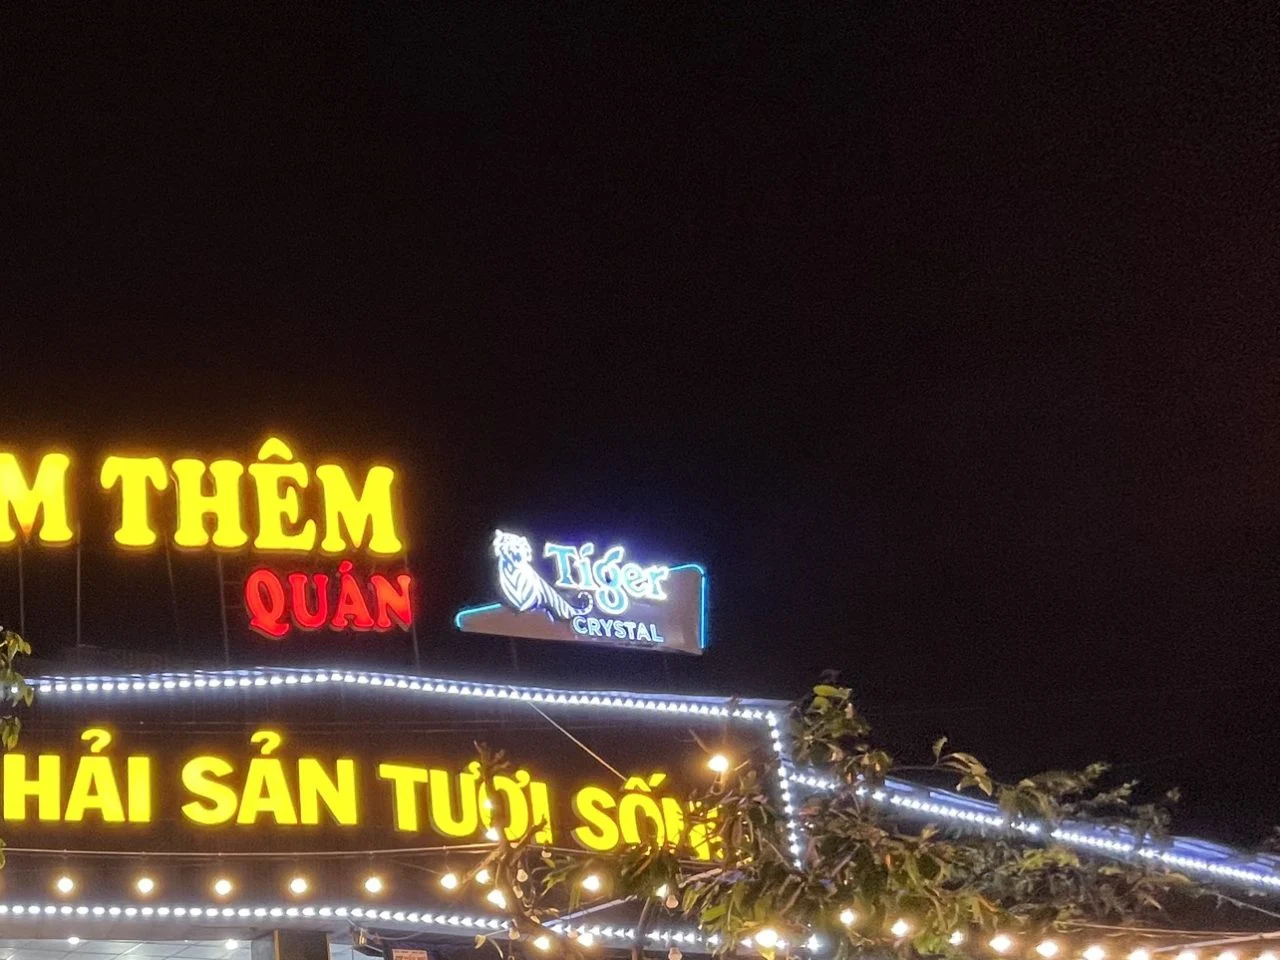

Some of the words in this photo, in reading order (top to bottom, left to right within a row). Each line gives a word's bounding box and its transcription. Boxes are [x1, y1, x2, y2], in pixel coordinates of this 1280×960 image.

[100, 437, 403, 553] THÊM
[243, 560, 413, 638] QUÁN
[543, 542, 670, 614] Tiger
[572, 614, 665, 643] CRYSTAL
[3, 728, 151, 822] HẢI
[180, 730, 358, 825] SẢN
[378, 760, 553, 846] TƯƠI
[573, 772, 724, 861] SỐN
